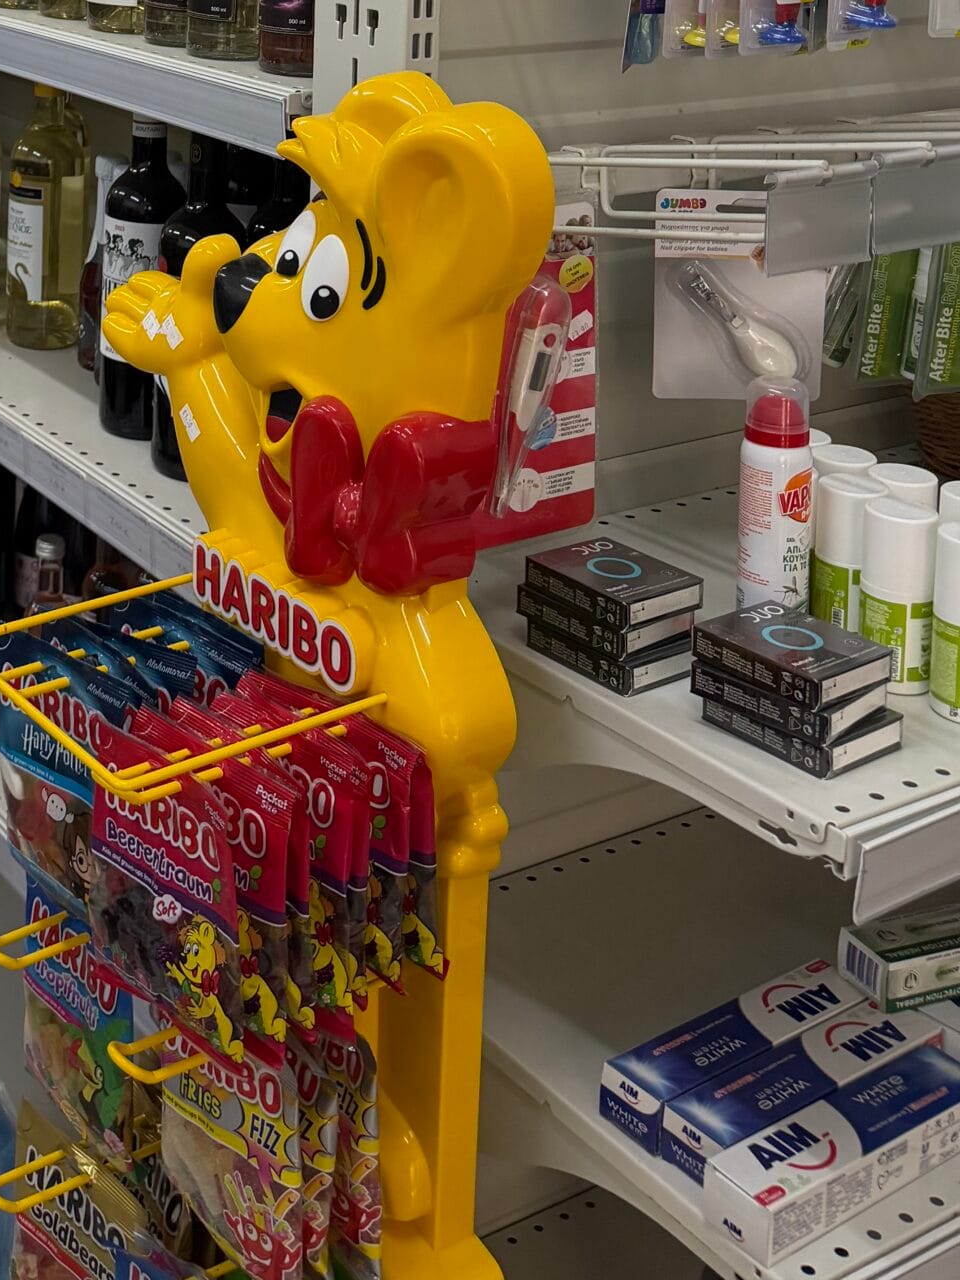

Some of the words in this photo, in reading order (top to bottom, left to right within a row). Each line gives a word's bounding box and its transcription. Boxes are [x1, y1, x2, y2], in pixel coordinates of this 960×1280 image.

[660, 198, 707, 209] JUMBO
[872, 256, 889, 302] Roll-o
[867, 303, 883, 334] Bite
[936, 308, 954, 340] Bite
[861, 337, 878, 376] After
[929, 345, 947, 382] After
[778, 484, 810, 515] VAP
[193, 542, 353, 687] HARIBO
[21, 723, 56, 761] Harry
[256, 784, 289, 810] Pocket
[260, 800, 278, 815] Size
[105, 816, 213, 903] Beerentraum
[154, 900, 178, 918] Soft
[776, 984, 840, 1022] AIM
[841, 1019, 908, 1062] AIM
[619, 1081, 639, 1100] AIM
[682, 1125, 702, 1145] AIM
[746, 1121, 822, 1172] AIM
[671, 1140, 705, 1171] WHIT
[722, 1218, 743, 1238] AIM
